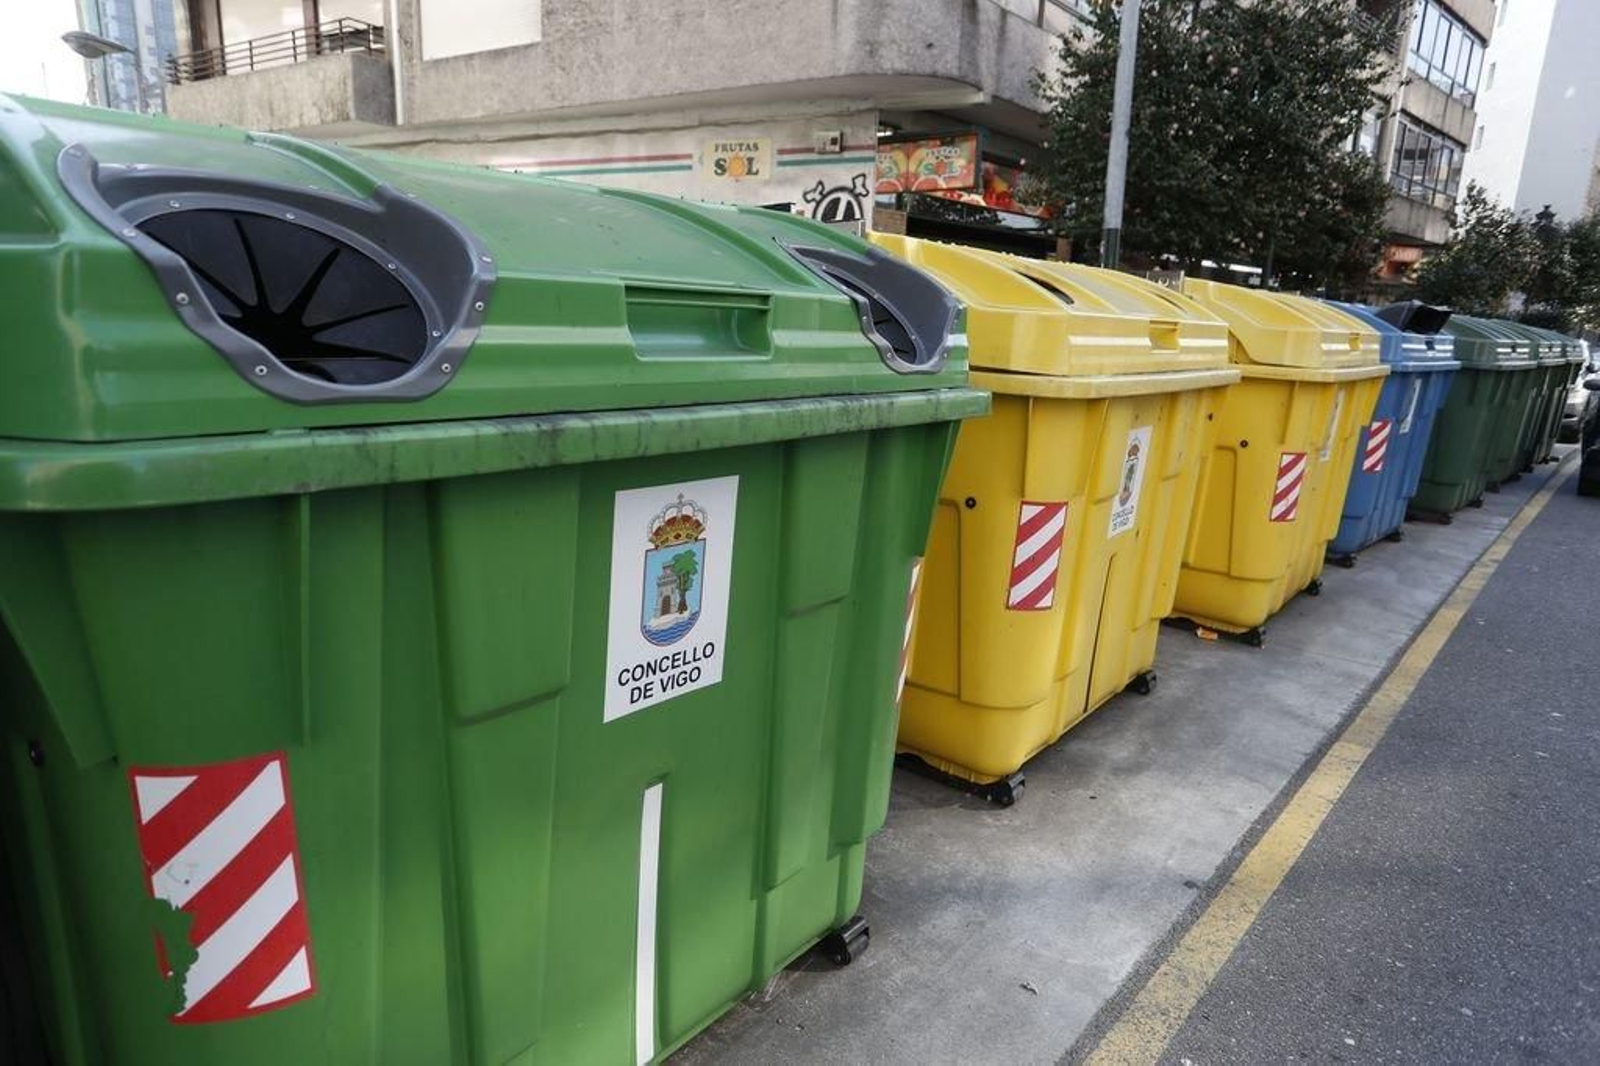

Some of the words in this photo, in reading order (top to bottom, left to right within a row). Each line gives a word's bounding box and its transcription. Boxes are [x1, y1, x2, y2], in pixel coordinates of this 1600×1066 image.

[714, 142, 759, 153] FRUTAS
[618, 642, 715, 686] CONCELLO
[630, 682, 653, 704] DE
[659, 666, 701, 693] VIGO
